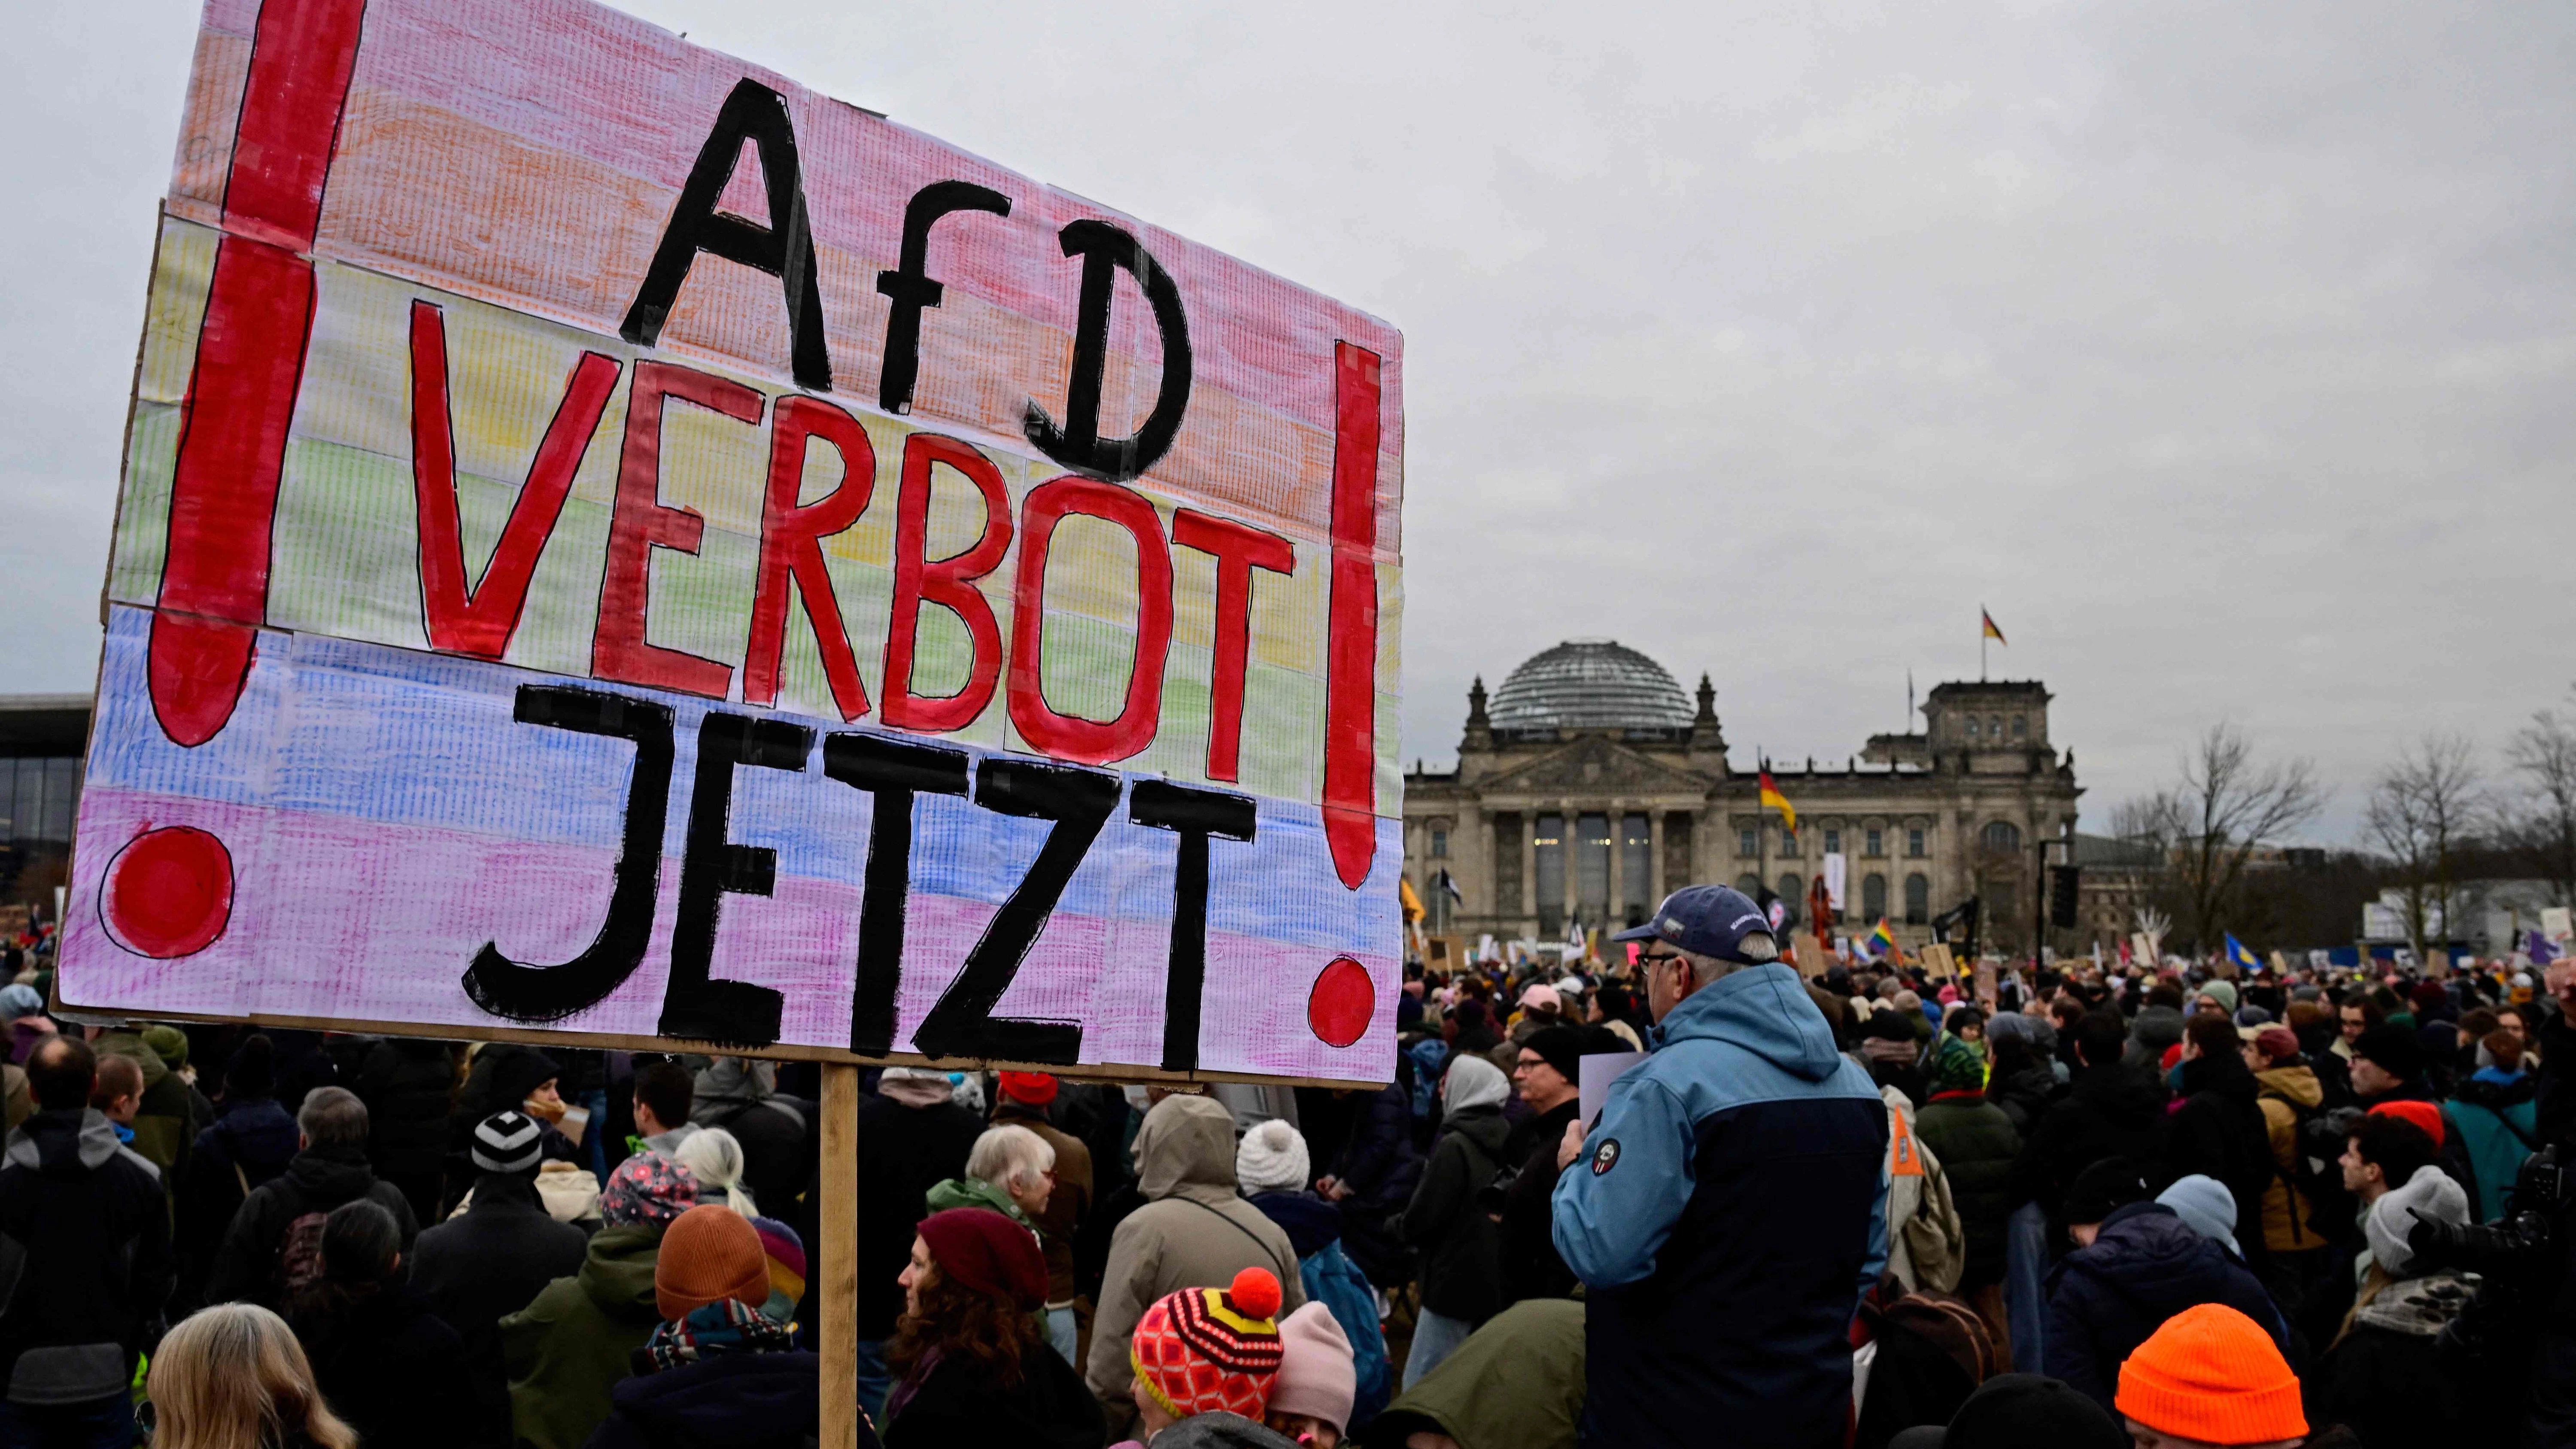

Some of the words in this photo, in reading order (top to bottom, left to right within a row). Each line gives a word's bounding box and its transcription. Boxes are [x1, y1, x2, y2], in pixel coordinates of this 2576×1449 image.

[619, 77, 1192, 480] AfD
[410, 299, 1295, 783] VERBOT
[1308, 339, 1382, 1048] !
[462, 683, 1256, 1073] JETZT
